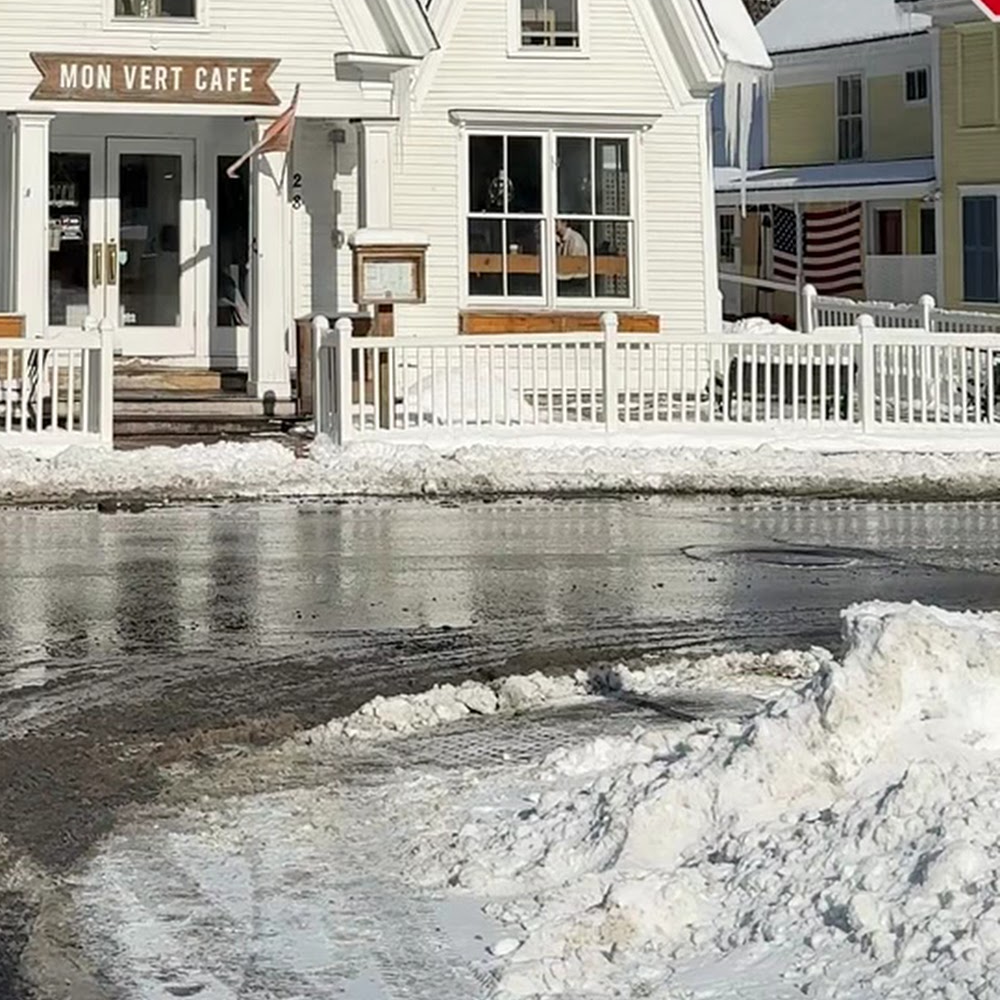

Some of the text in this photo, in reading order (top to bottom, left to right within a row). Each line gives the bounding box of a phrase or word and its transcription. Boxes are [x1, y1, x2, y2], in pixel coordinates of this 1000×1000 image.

[60, 64, 253, 92] MON VERT CAFE
